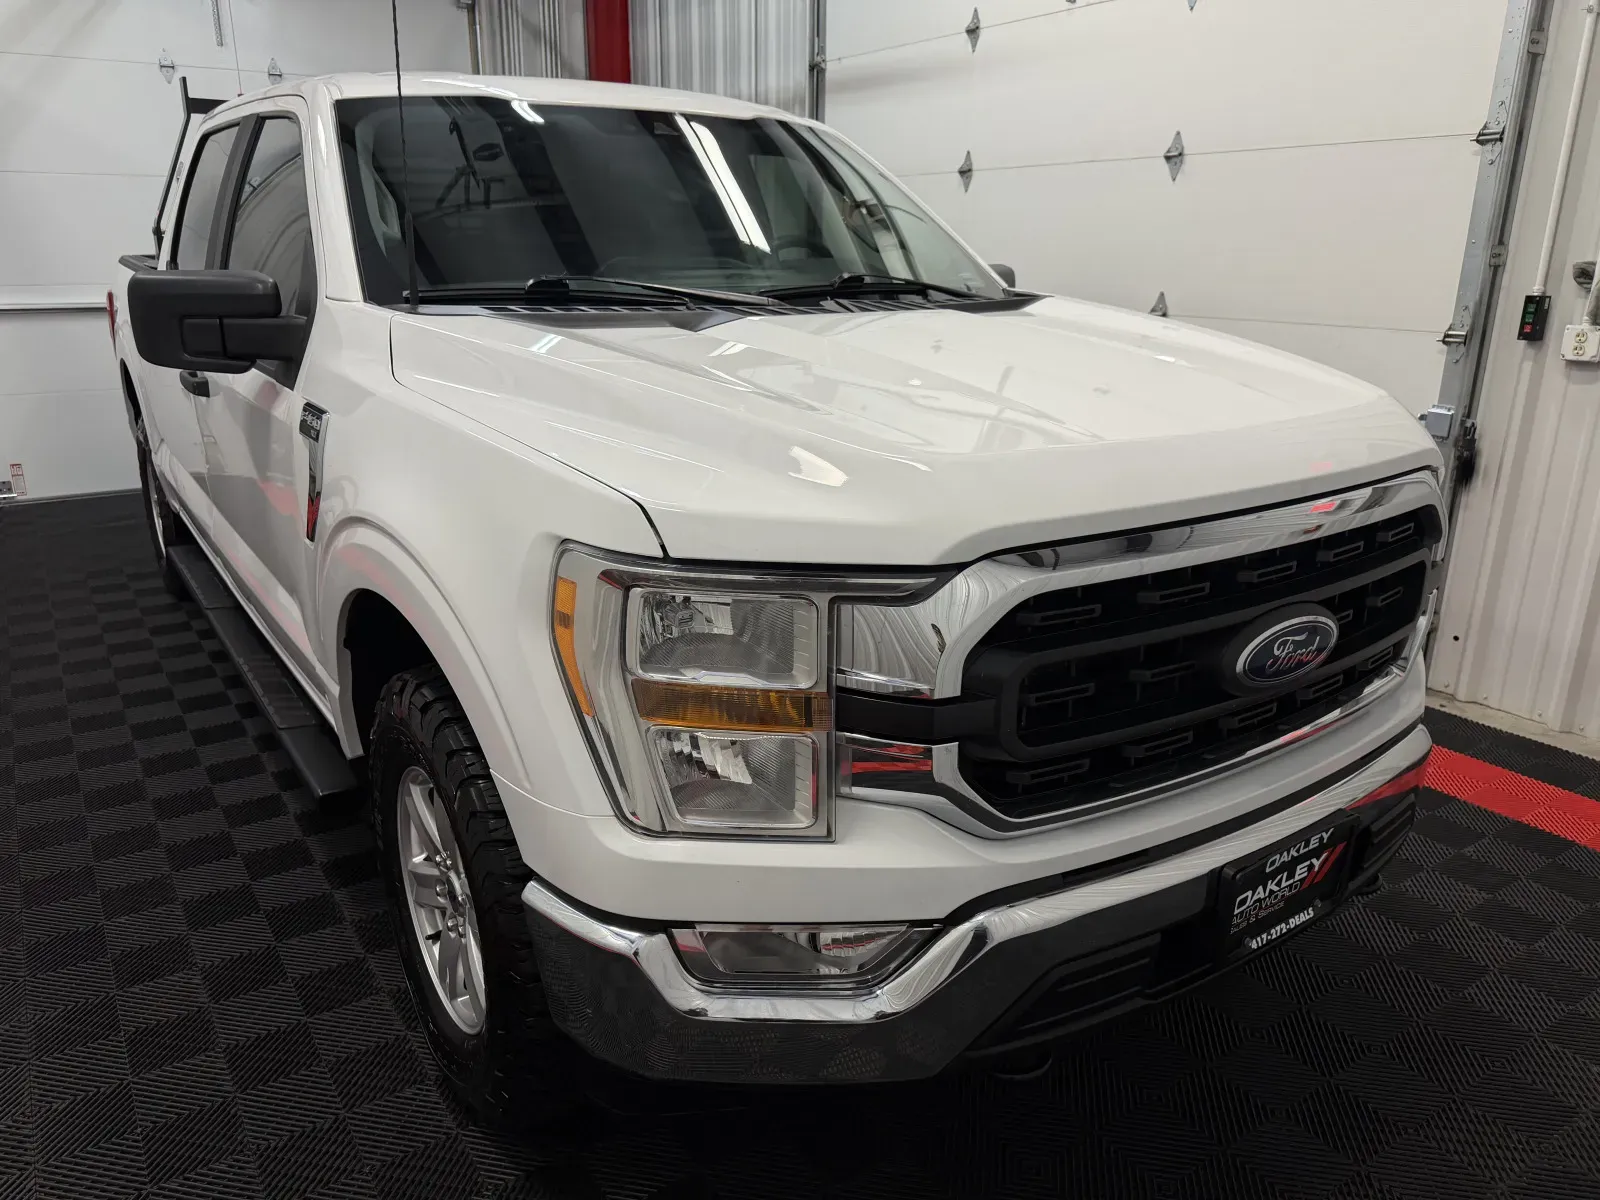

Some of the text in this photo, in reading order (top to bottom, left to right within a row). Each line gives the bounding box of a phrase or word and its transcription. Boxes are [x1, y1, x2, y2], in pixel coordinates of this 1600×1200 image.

[1265, 632, 1320, 674] Ford
[1266, 828, 1334, 873] OAKLEY
[1232, 882, 1300, 925] AUTO WORLD
[1234, 852, 1328, 915] OAKLEY
[1251, 907, 1314, 949] 417-272-DEALS
